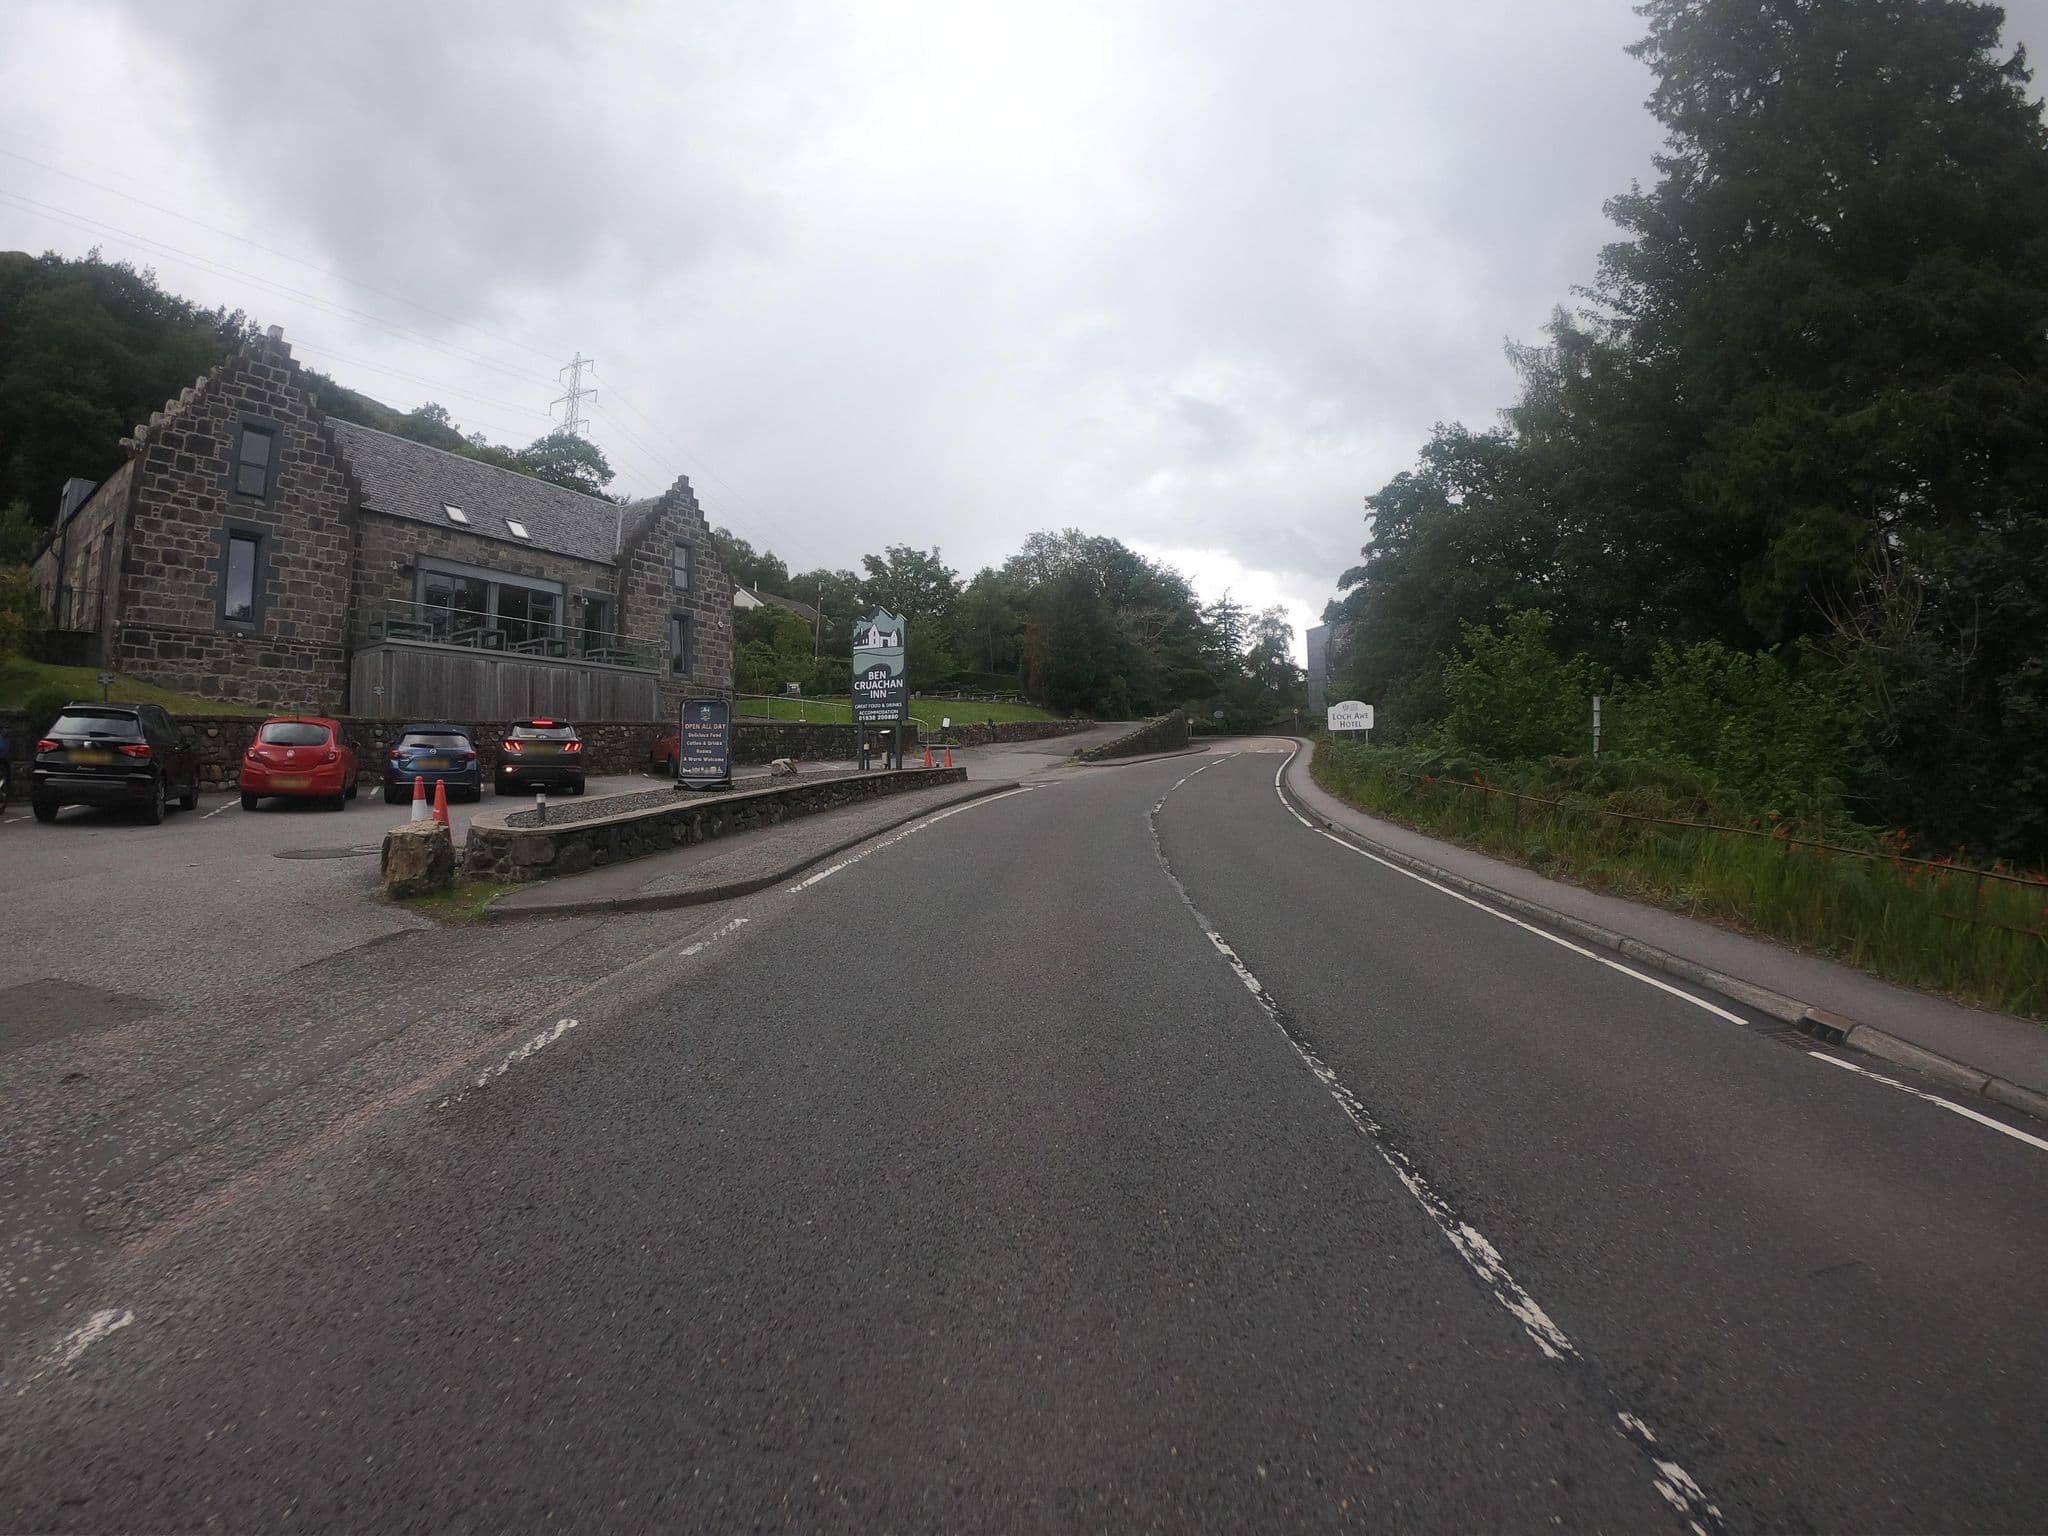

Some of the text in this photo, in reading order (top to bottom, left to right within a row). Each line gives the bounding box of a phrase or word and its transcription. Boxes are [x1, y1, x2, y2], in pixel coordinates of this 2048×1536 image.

[868, 671, 887, 680] BEN
[854, 679, 904, 690] CRUACHAN
[870, 690, 887, 699] INN
[1332, 712, 1369, 721] LOCH AWE
[1339, 720, 1362, 728] HOTEL
